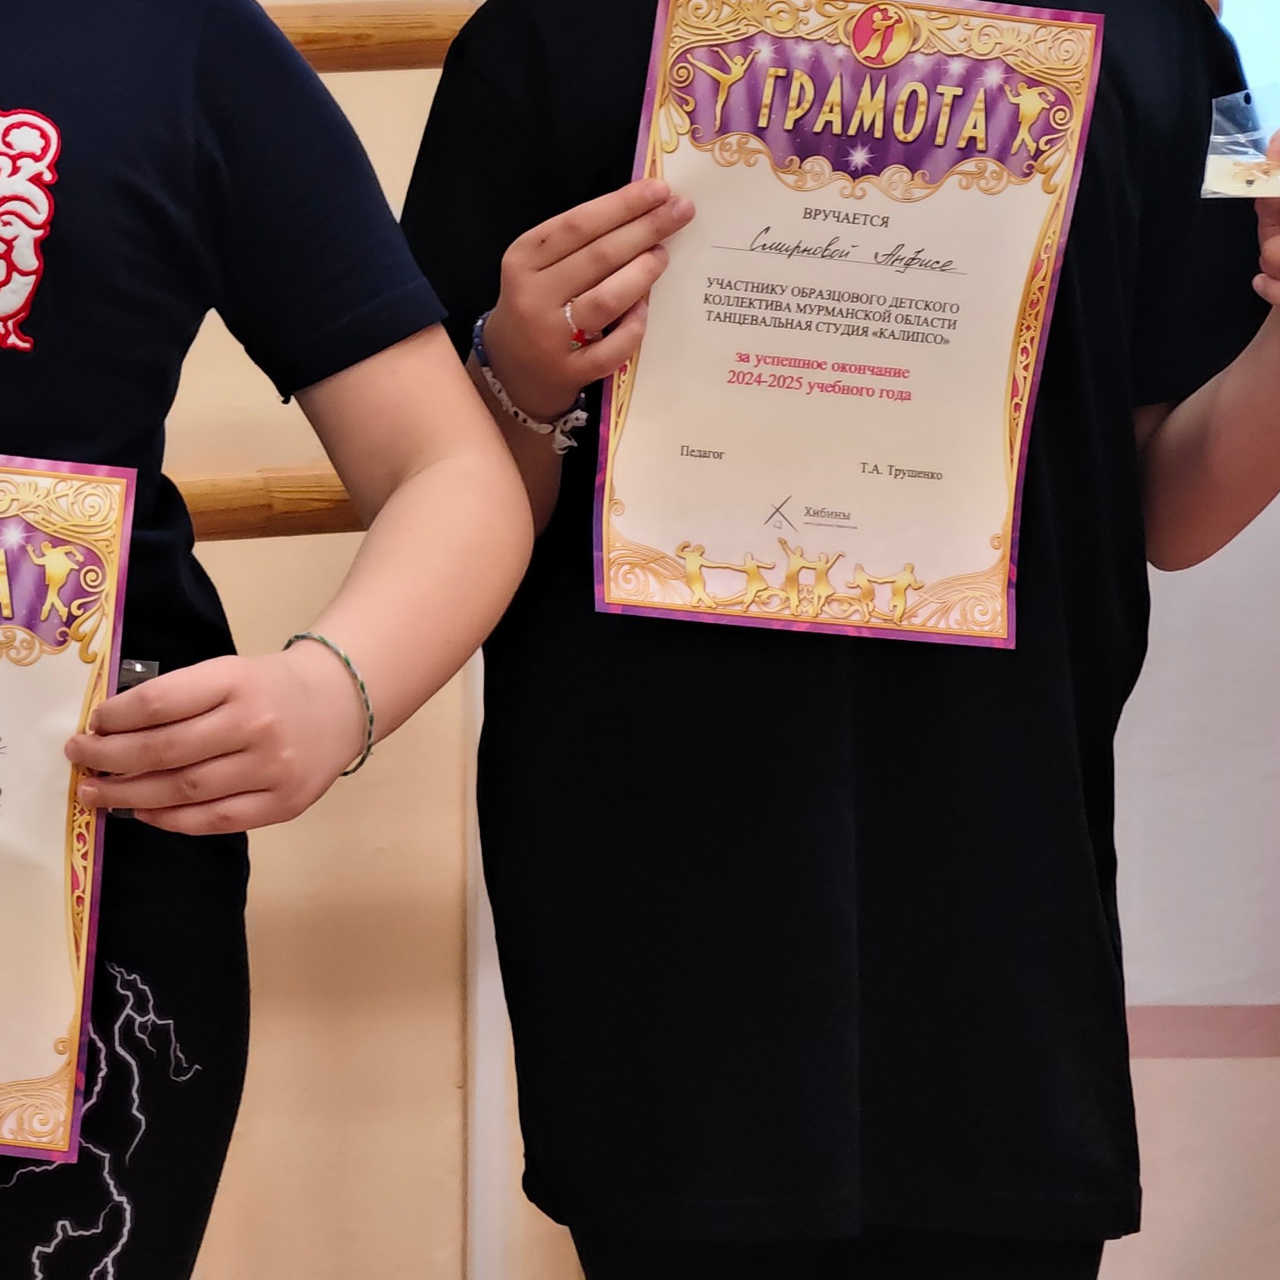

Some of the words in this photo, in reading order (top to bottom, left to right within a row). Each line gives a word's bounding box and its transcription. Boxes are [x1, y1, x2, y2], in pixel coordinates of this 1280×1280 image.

[756, 66, 988, 152] ГРАМОТА
[803, 207, 890, 228] ВРУЧАЕТСЯ
[706, 277, 788, 296] УЧАСТНИКУ
[791, 285, 887, 307] ОБРАЗЦОВОГО
[889, 296, 960, 315] ДЕТСКОГО
[703, 293, 791, 313] КОЛЛЕКТИВА
[795, 302, 892, 324] МУРМАНСКОЙ
[894, 313, 957, 330] ОБЛАСТИ
[706, 310, 813, 332] ТАНЦЕВАЛЬНАЯ
[815, 322, 869, 337] СТУДИЯ
[872, 328, 950, 346] «КАЛИПСО»
[735, 351, 750, 363] за
[755, 353, 828, 372] успешное
[831, 361, 910, 379] окончание
[727, 370, 804, 390] 2024-2025
[806, 379, 875, 398] учебного
[878, 387, 913, 402] года
[680, 445, 725, 460] Педагог
[860, 462, 883, 475] Т.А.
[887, 464, 943, 481] Трушенко
[804, 506, 851, 521] Хибины
